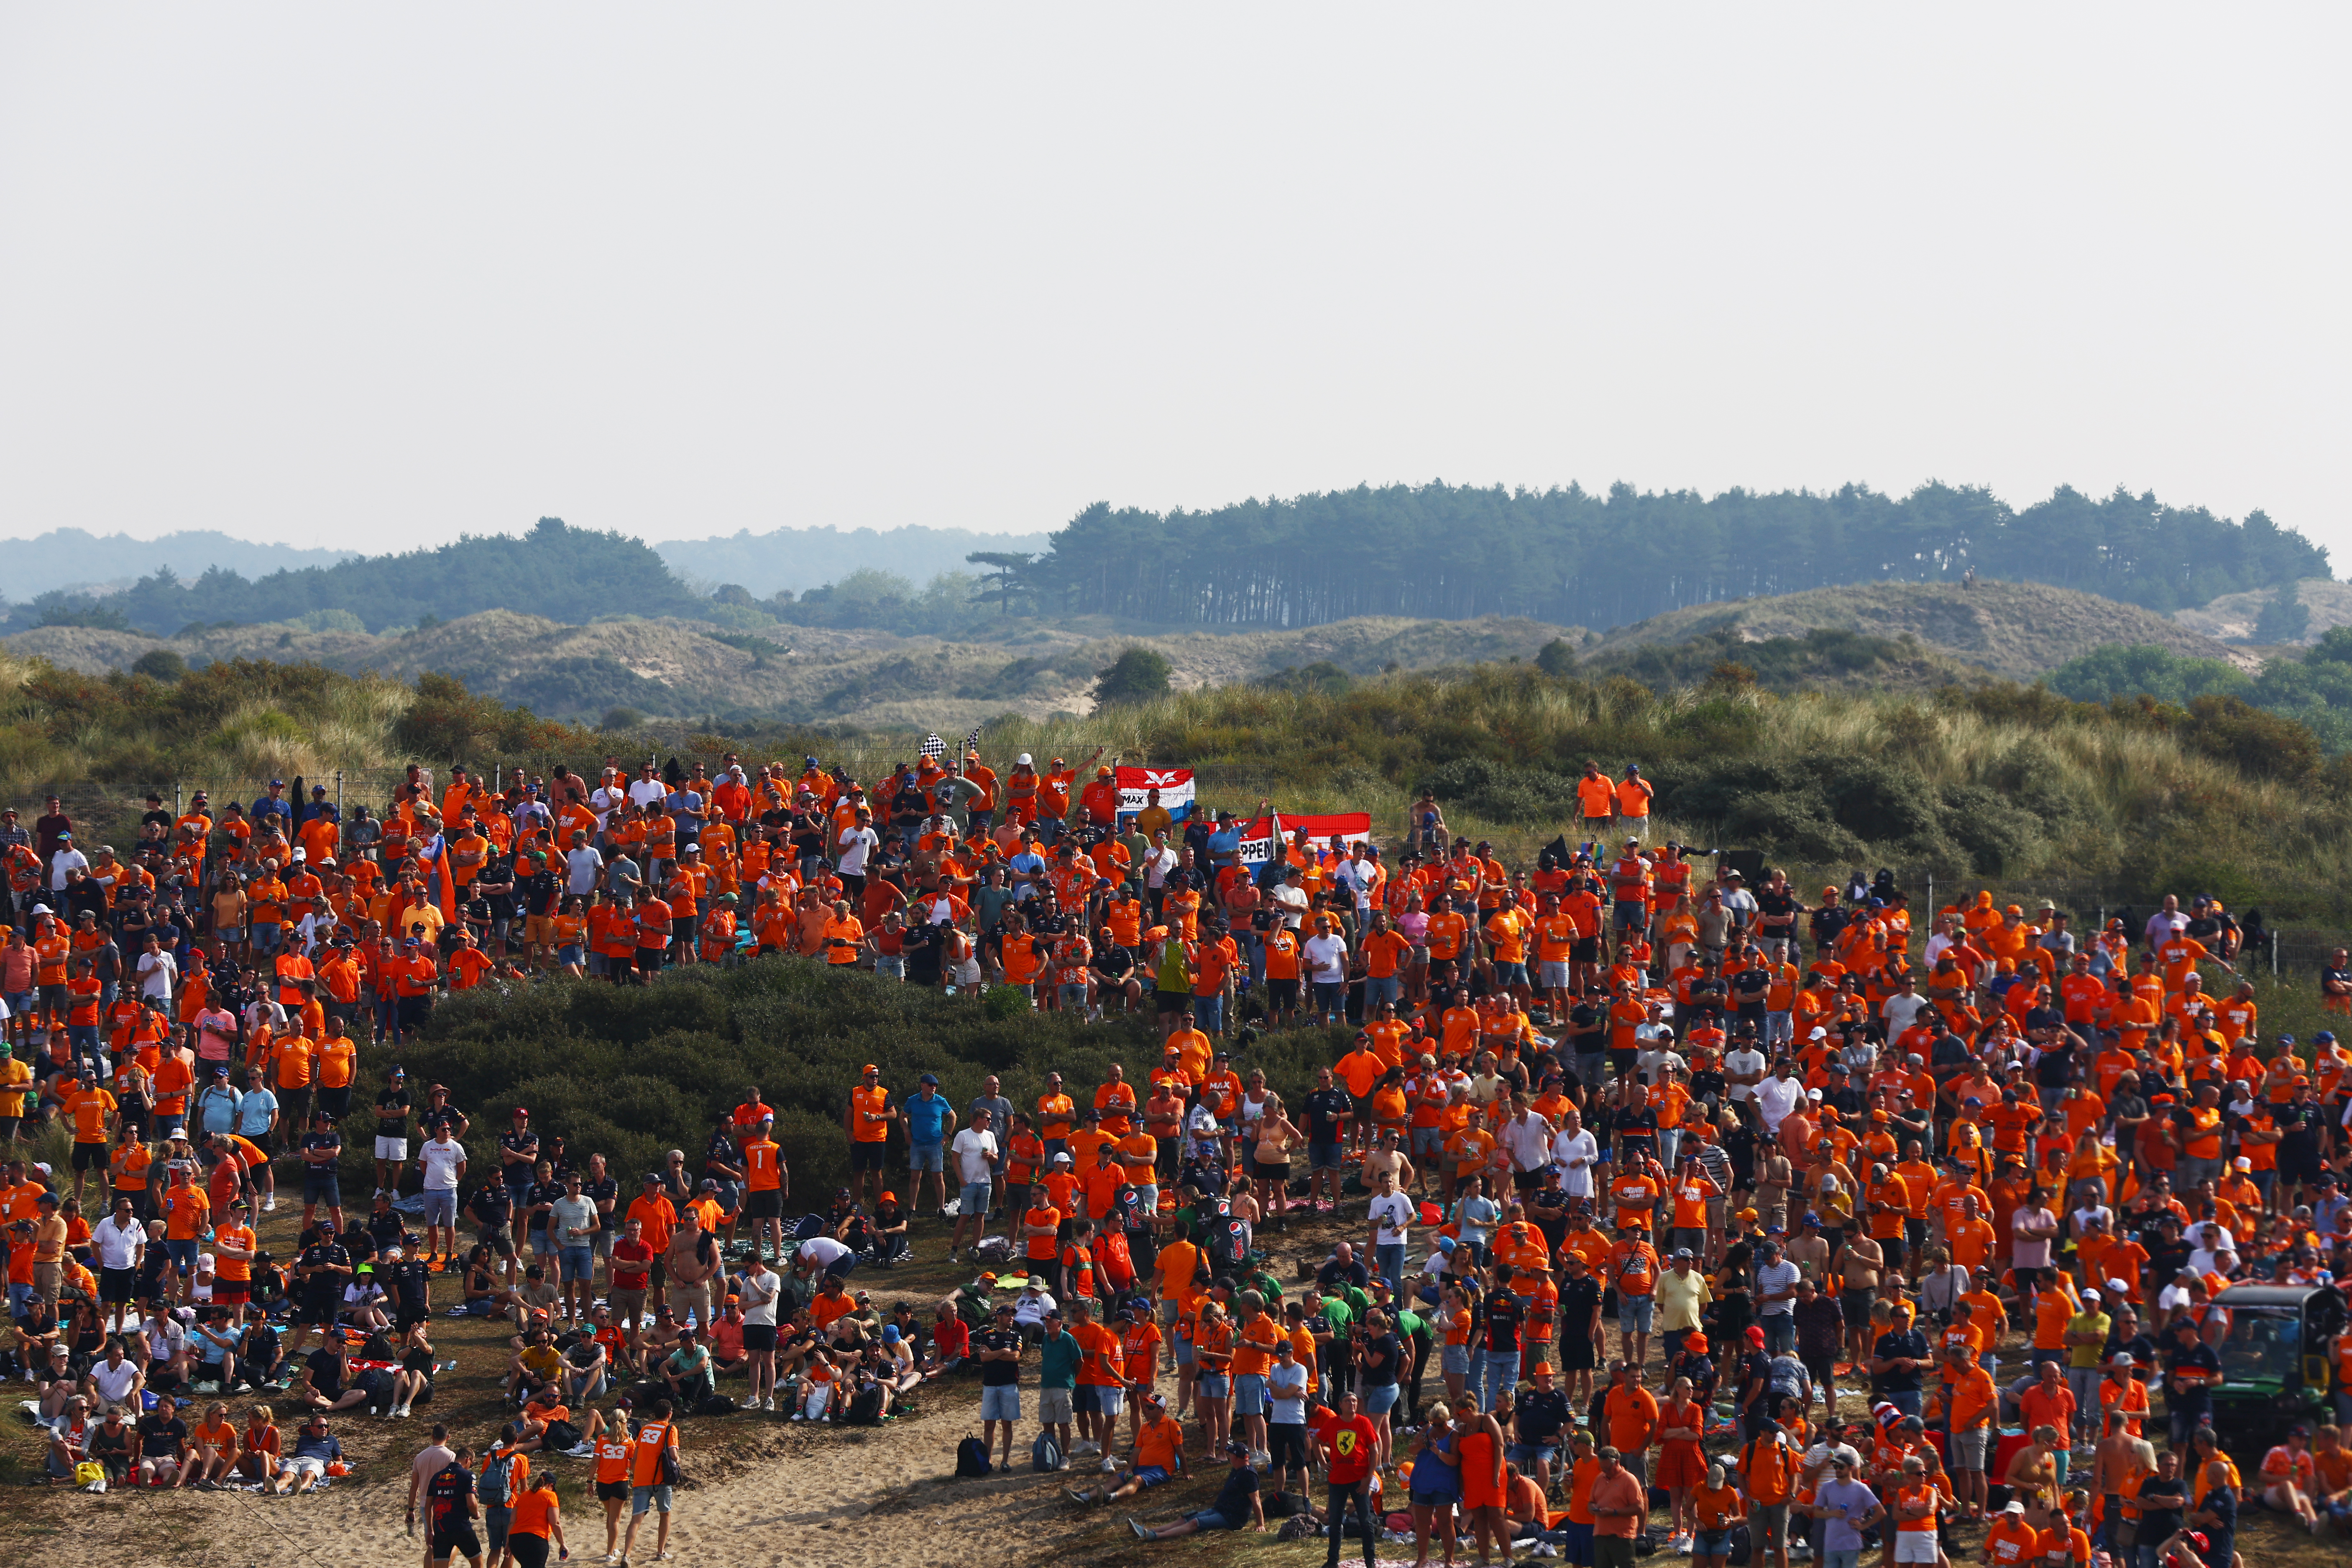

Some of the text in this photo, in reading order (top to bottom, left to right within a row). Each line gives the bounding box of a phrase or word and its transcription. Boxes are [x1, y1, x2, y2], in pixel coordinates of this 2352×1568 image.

[1122, 795, 1143, 804] MAX
[1240, 841, 1272, 859] PPEN
[1210, 1081, 1230, 1089] MAX
[757, 1150, 762, 1168] 1
[1232, 1236, 1244, 1260] MAX
[641, 1429, 661, 1444] 33
[603, 1445, 626, 1459] 33
